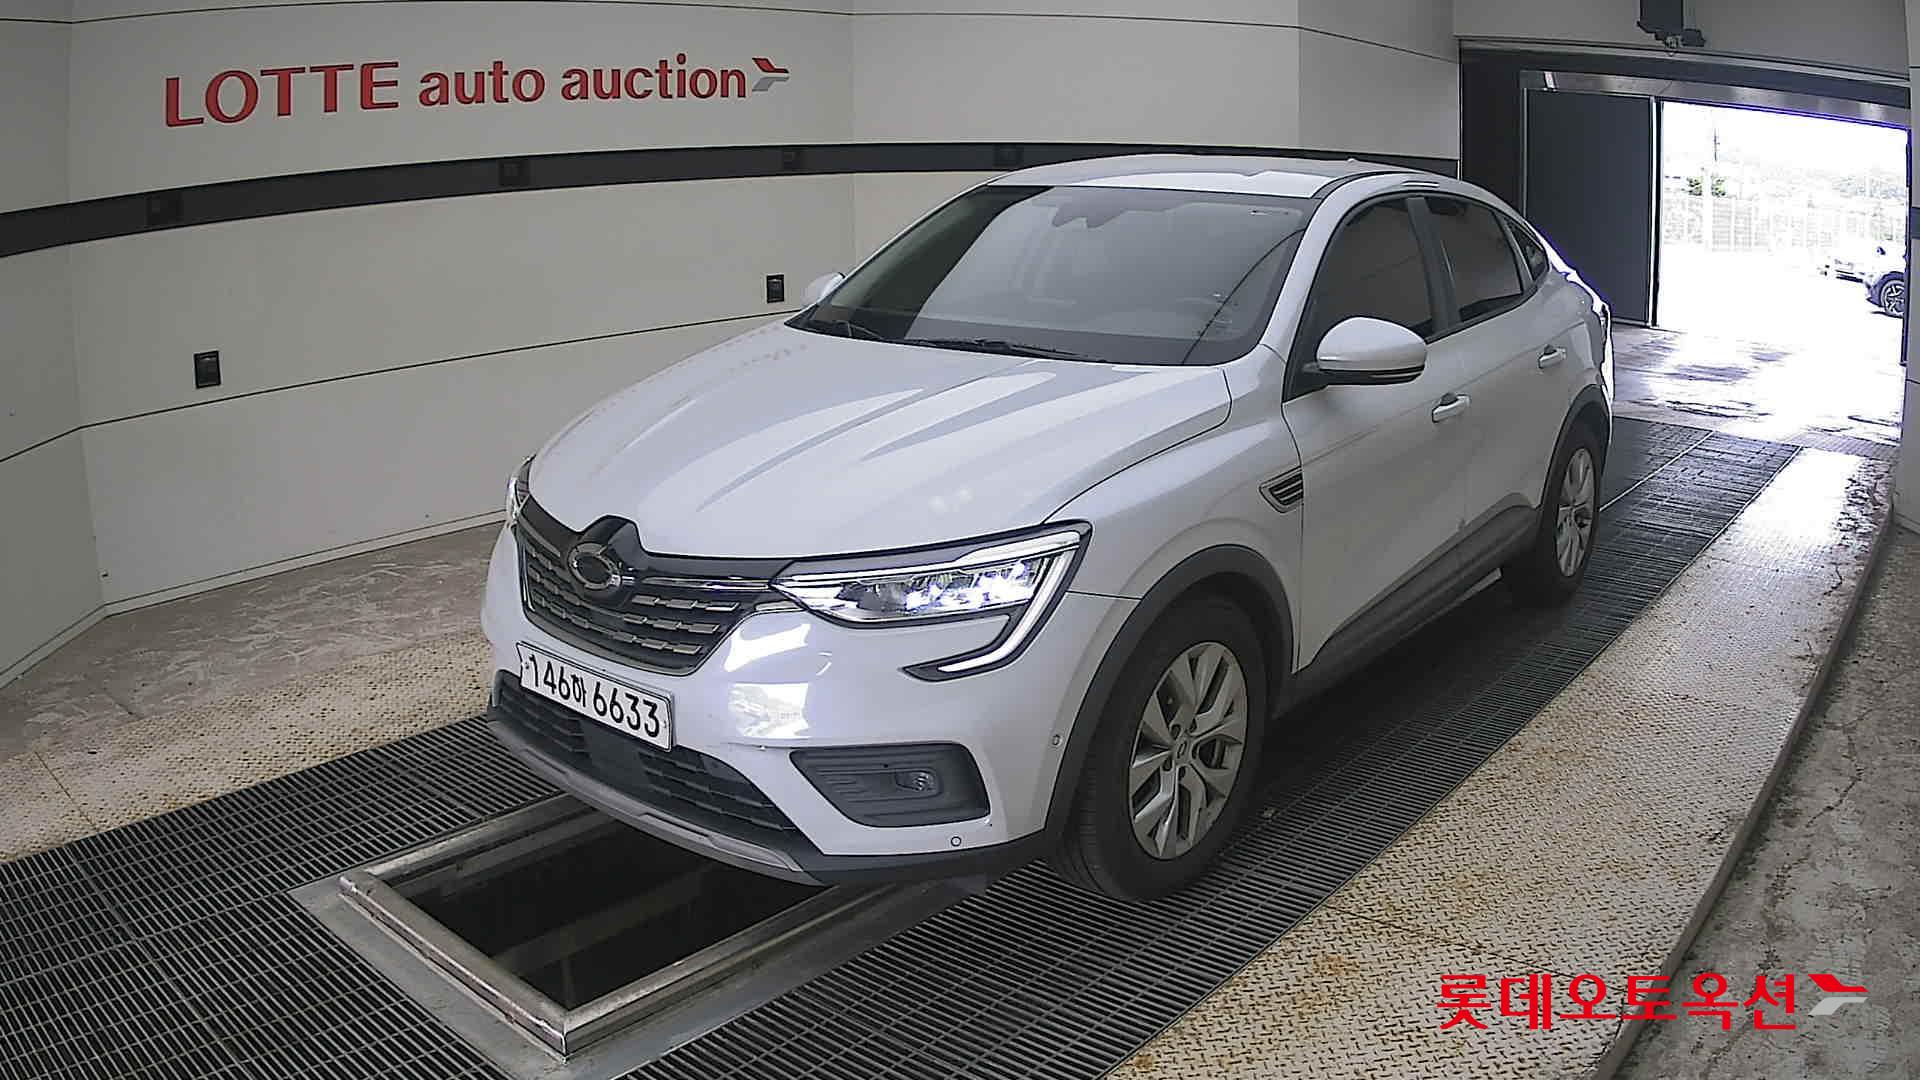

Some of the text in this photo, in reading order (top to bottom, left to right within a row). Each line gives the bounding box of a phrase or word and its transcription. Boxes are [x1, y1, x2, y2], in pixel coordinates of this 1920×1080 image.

[165, 53, 747, 127] LOTTE auto auction
[529, 654, 661, 738] 146하 6633
